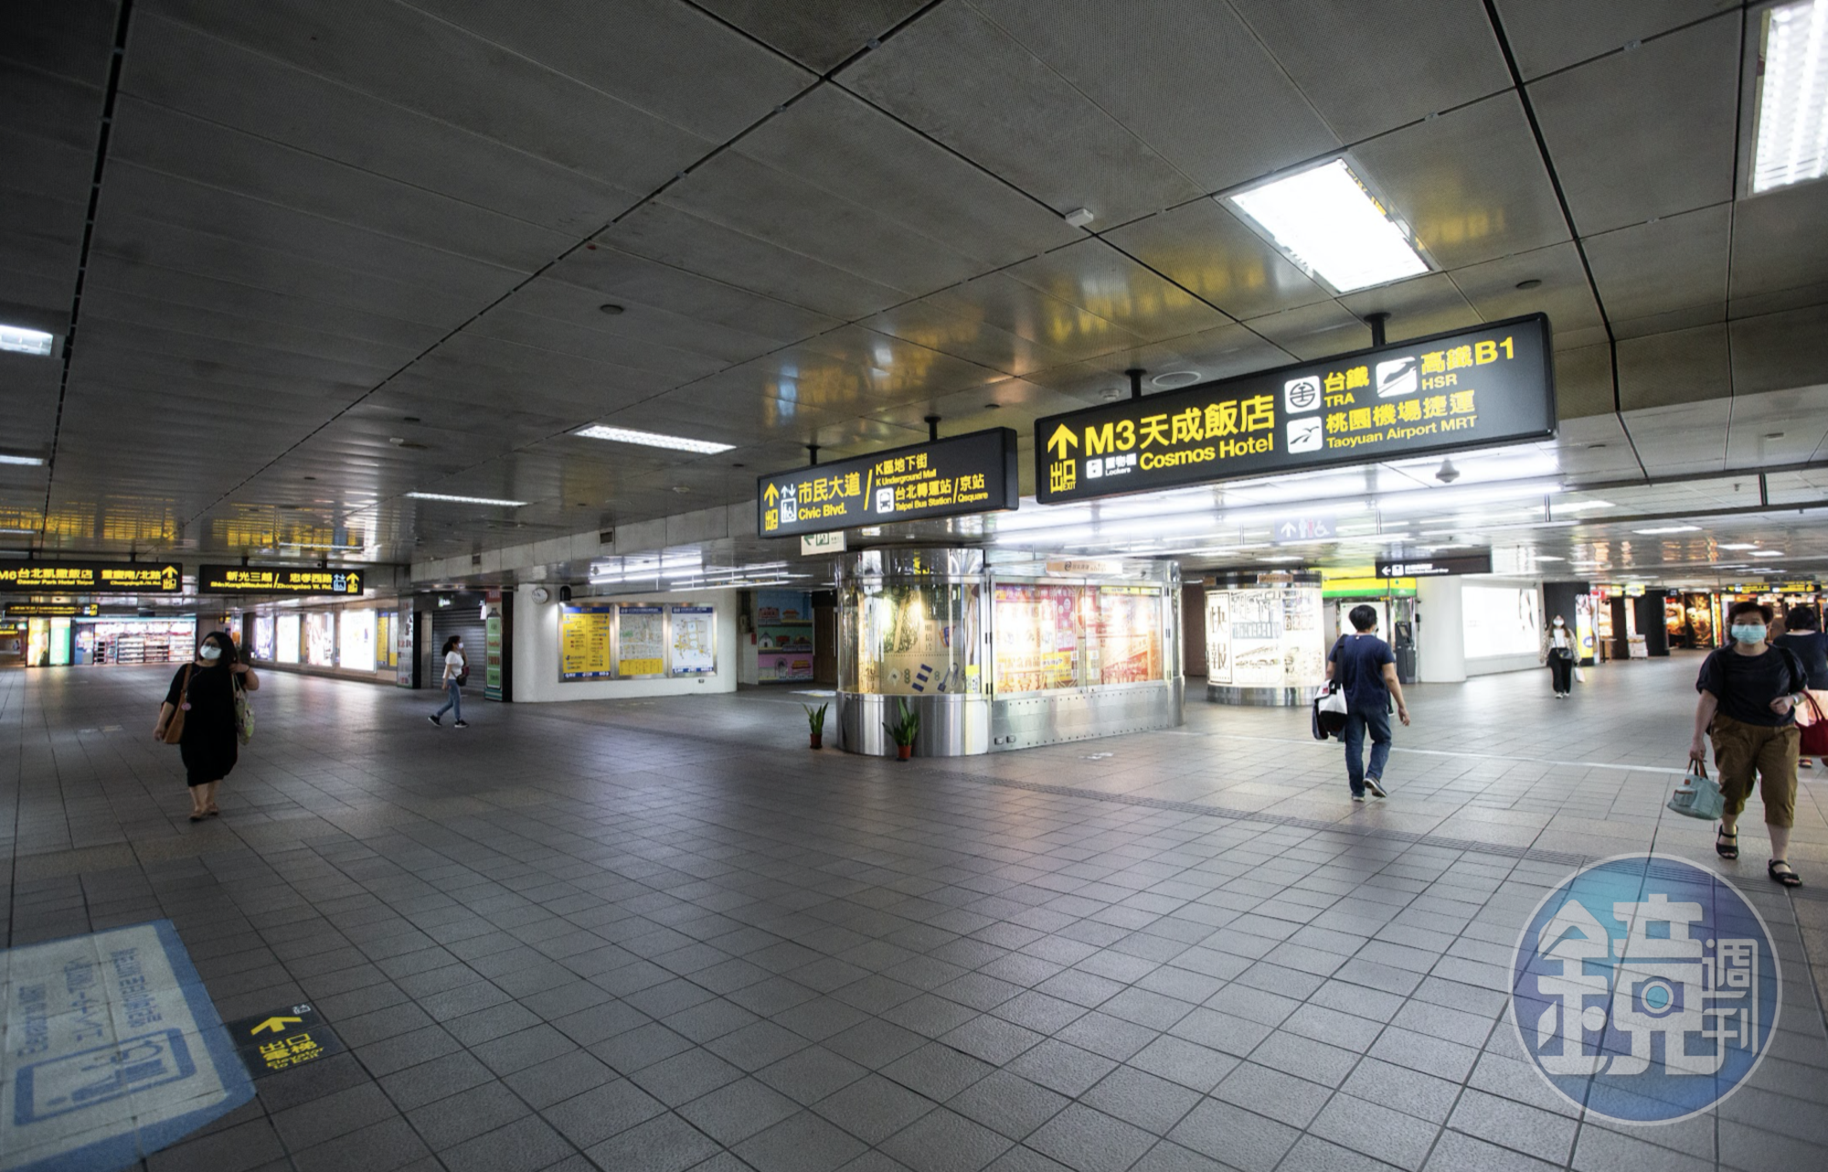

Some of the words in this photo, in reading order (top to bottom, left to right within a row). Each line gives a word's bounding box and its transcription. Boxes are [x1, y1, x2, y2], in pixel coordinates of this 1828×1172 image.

[1323, 365, 1370, 394] 台鐵
[1421, 373, 1458, 391] HSR
[1324, 392, 1355, 408] TRA
[1325, 389, 1476, 434] 桃園機場捷運
[1326, 432, 1383, 449] Taoyuan
[1386, 423, 1437, 440] Airport
[1441, 415, 1478, 432] MRT
[1139, 446, 1216, 471] Cosmos
[1219, 432, 1274, 459] Hotel
[797, 471, 861, 504] 市民大道
[881, 471, 922, 485] Underground
[959, 473, 985, 492] 京站
[1049, 458, 1077, 494] 出口
[797, 506, 822, 521] Civic
[822, 502, 847, 518] Blvd.
[894, 501, 914, 512] Taipei
[914, 498, 928, 509] Bus
[928, 495, 953, 507] Station
